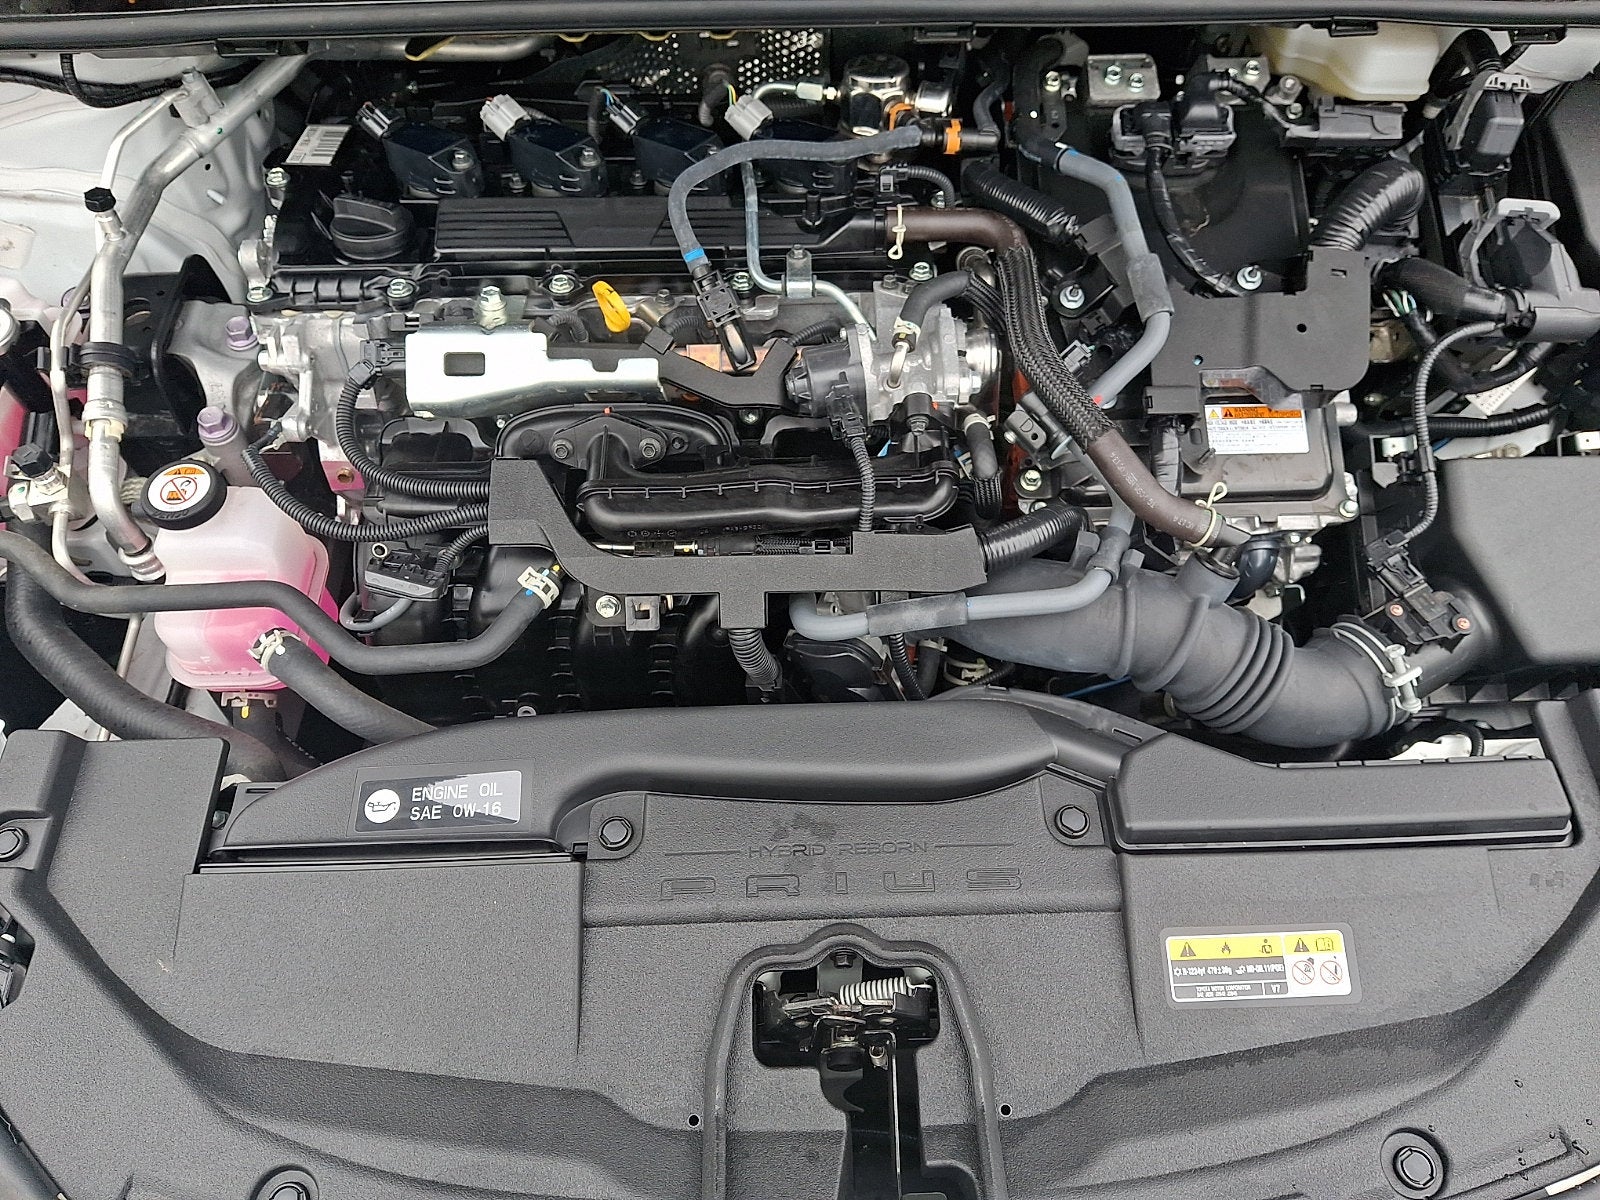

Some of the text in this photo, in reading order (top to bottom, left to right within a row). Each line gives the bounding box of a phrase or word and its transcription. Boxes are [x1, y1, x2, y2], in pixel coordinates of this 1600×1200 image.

[411, 782, 503, 801] ENGINE OIL
[410, 802, 502, 821] SAE 0W-16
[749, 840, 927, 858] HYBRID REBORN
[660, 867, 1023, 902] PRIUS
